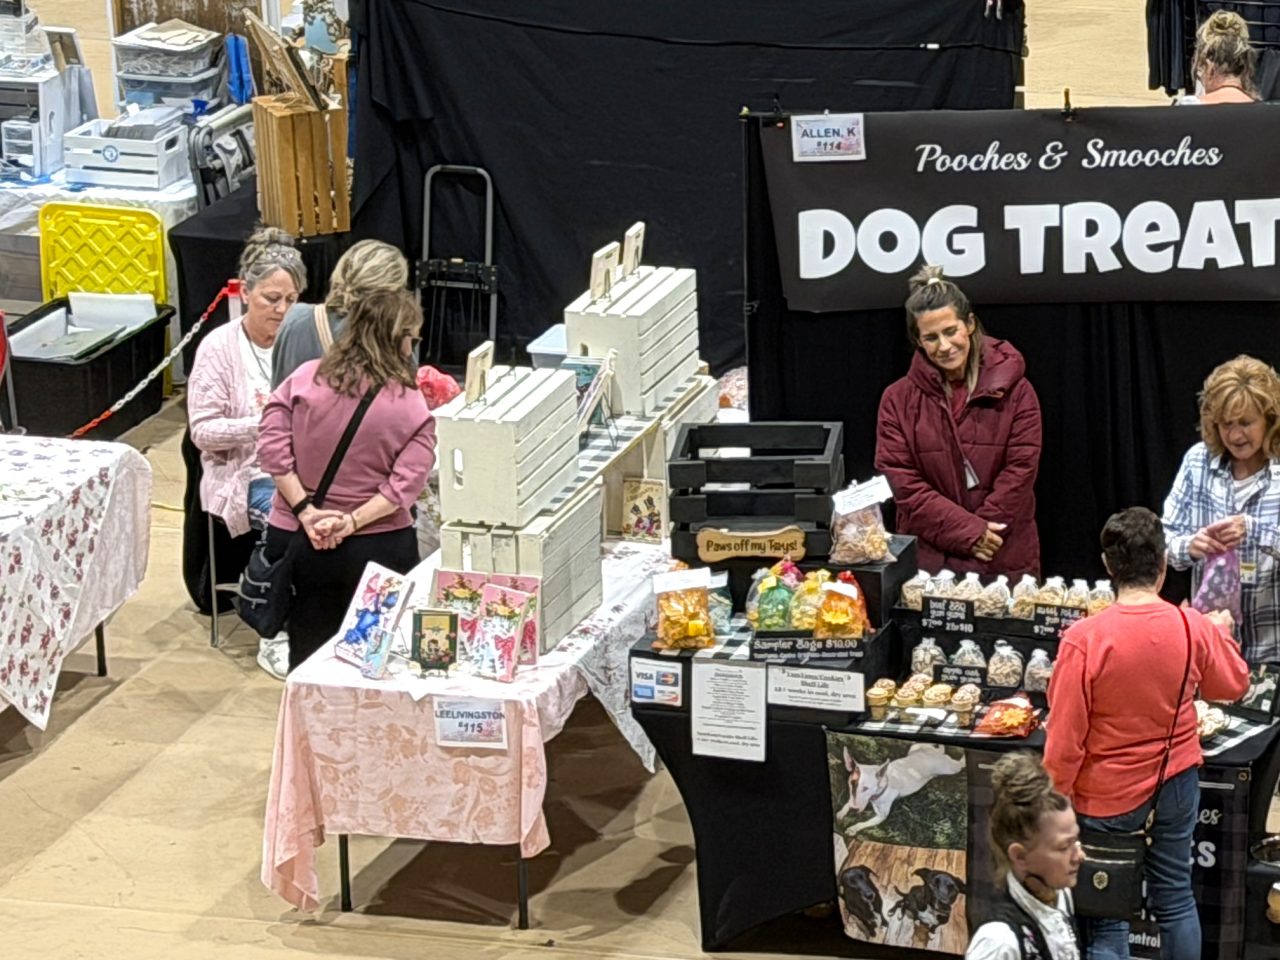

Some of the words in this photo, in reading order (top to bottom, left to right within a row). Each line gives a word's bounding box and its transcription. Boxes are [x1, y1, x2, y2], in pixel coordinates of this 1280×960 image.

[801, 127, 844, 139] ALLEN,
[847, 127, 856, 137] K
[915, 141, 1031, 173] Pooches
[1038, 141, 1069, 171] &
[1081, 136, 1222, 169] Smooches
[798, 204, 986, 279] DOG
[706, 540, 732, 552] Paws
[734, 540, 749, 551] off
[750, 543, 766, 553] my
[753, 640, 794, 651] Sampler
[796, 640, 823, 651] Bags
[825, 639, 858, 649] $10.00
[635, 672, 654, 680] VISA
[458, 721, 483, 733] #115
[1128, 932, 1161, 948] ontrol
